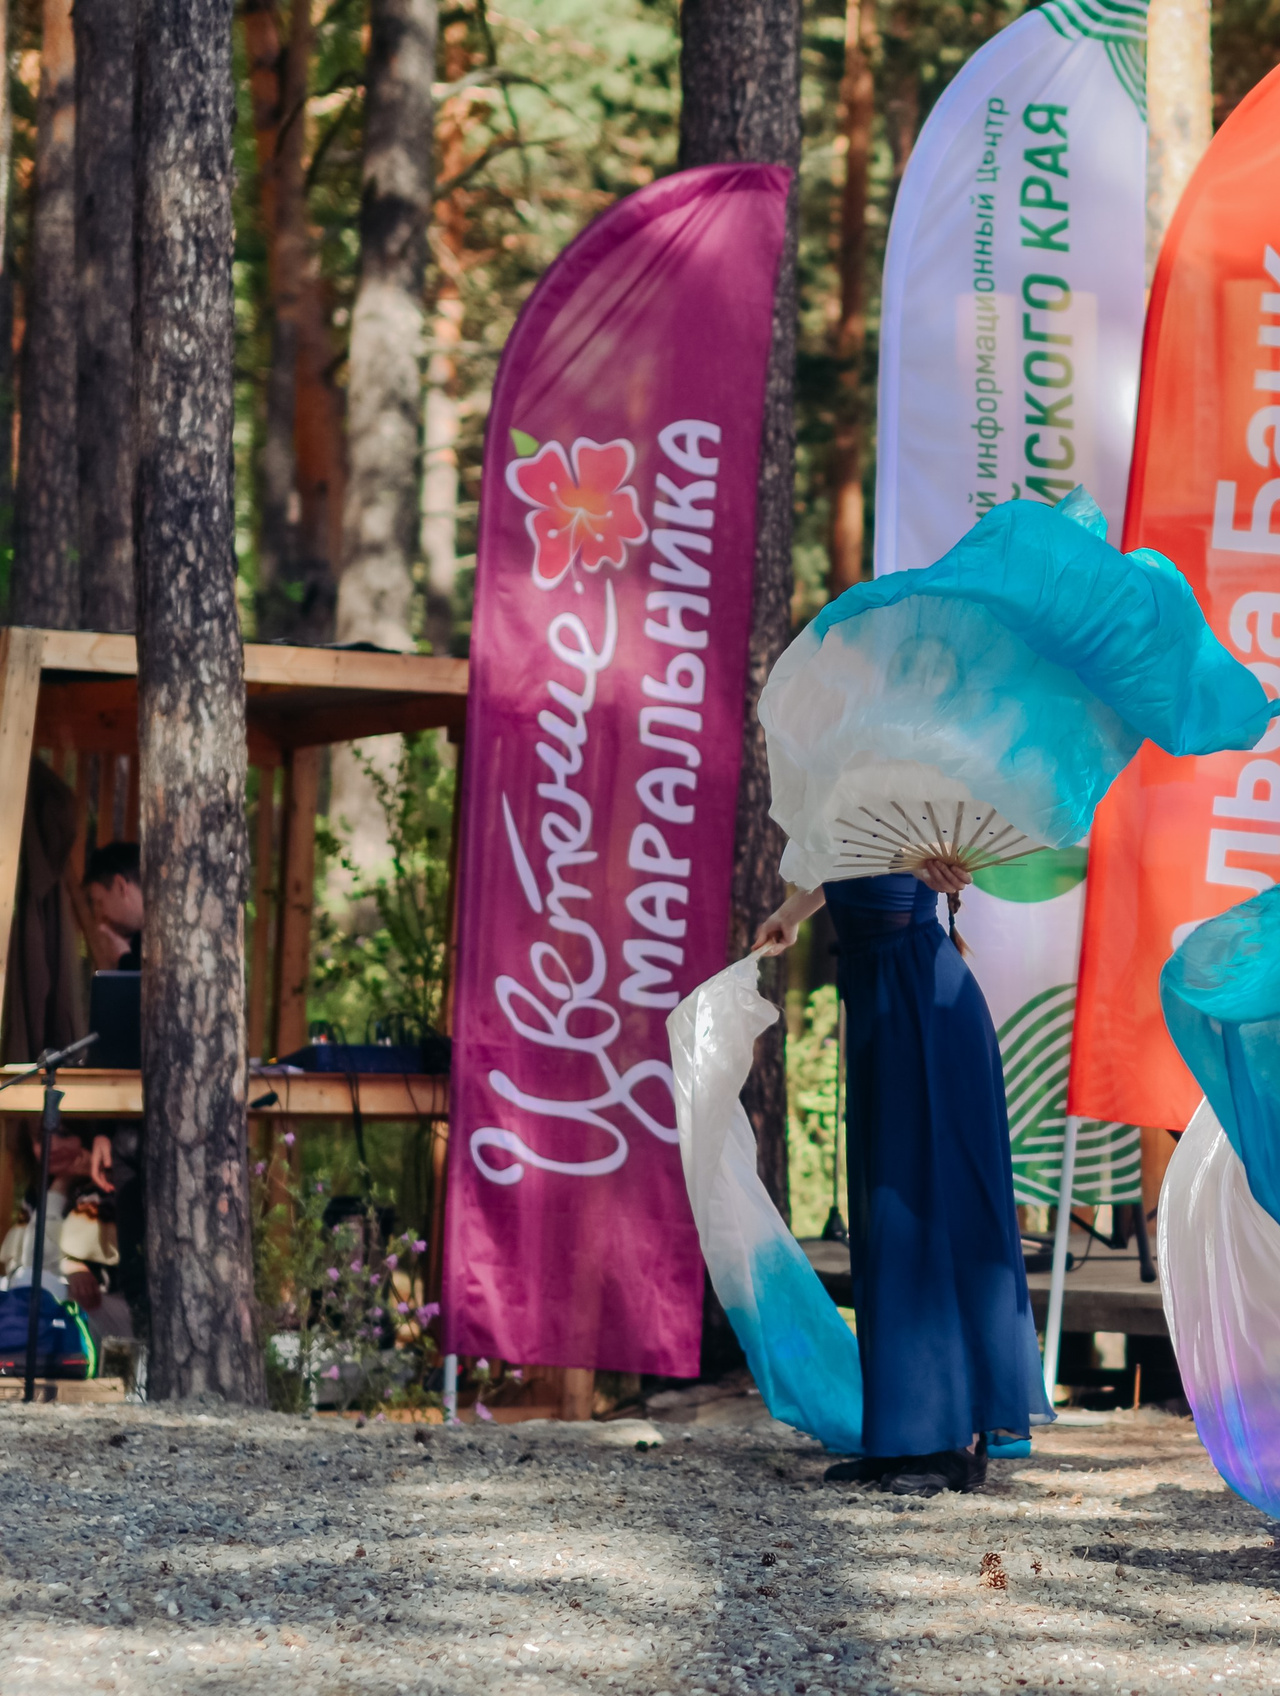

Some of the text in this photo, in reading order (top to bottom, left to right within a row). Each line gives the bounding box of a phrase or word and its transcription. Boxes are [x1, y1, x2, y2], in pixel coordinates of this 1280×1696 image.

[970, 194, 1005, 480] информационный
[1011, 101, 1076, 507] ЙСКОГО КРАЯ
[470, 578, 681, 1185] Цветение
[619, 418, 722, 1010] МАРАЛЬНИКА
